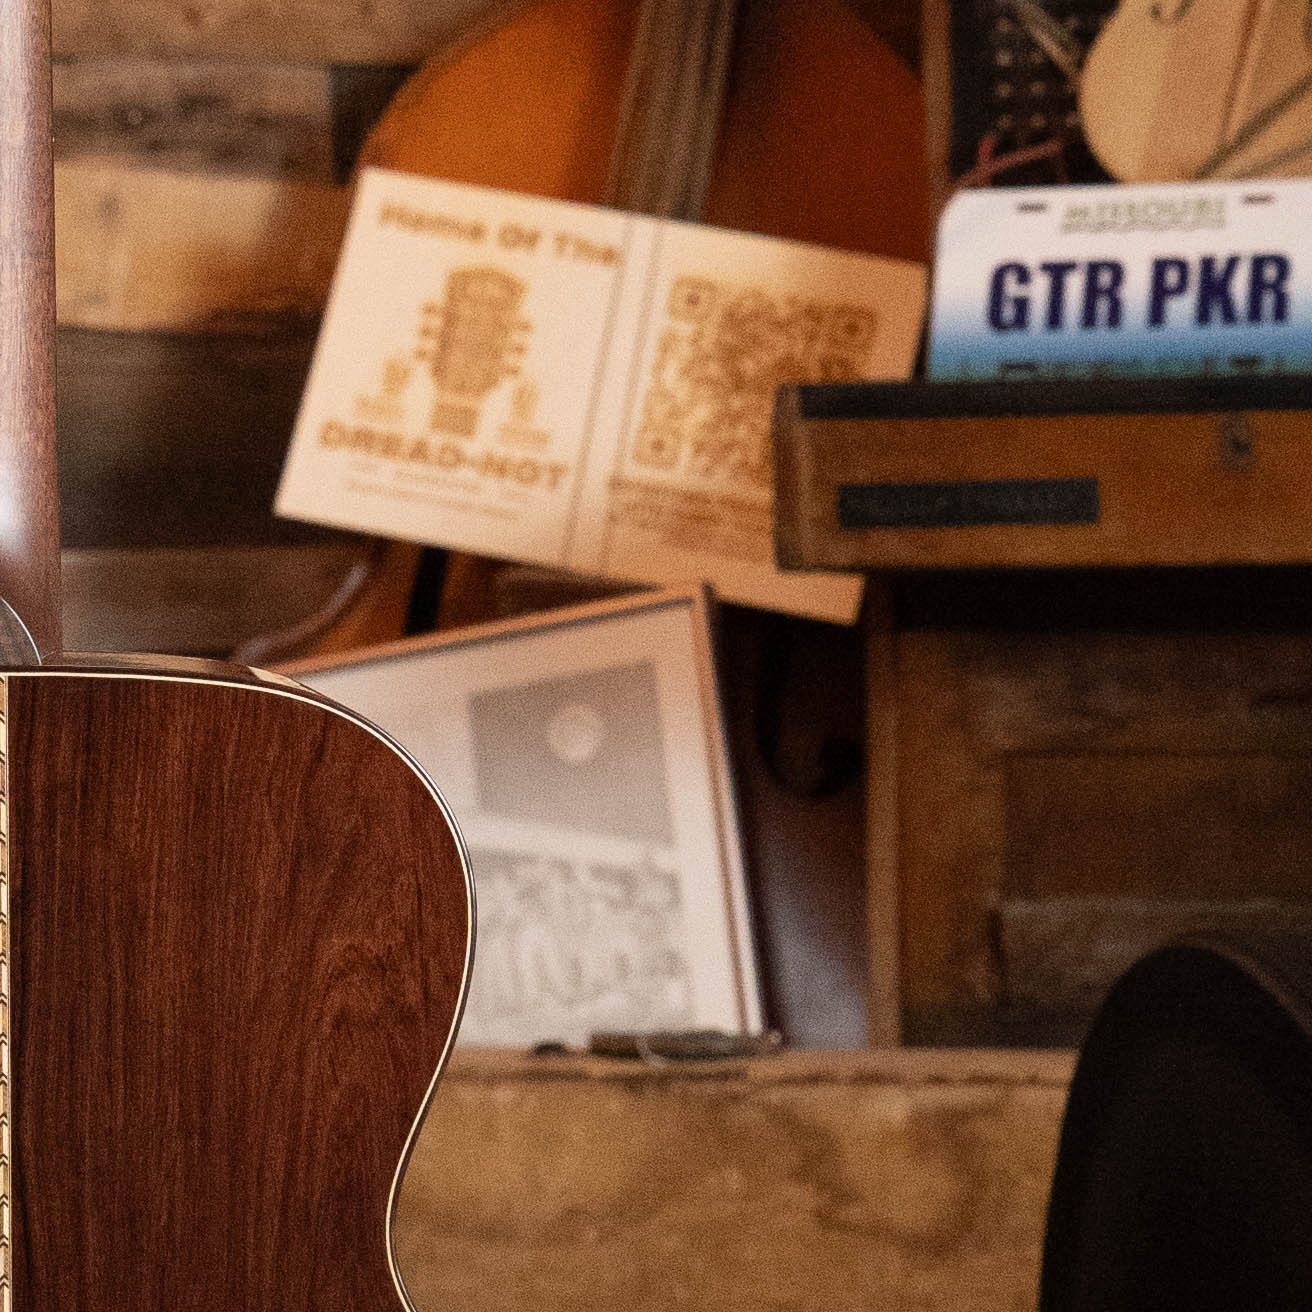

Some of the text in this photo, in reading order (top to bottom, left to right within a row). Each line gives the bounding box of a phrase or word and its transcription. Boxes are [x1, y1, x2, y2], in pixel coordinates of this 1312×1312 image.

[988, 252, 1292, 334] GTR PKR
[320, 418, 571, 490] DREAD-NOT
